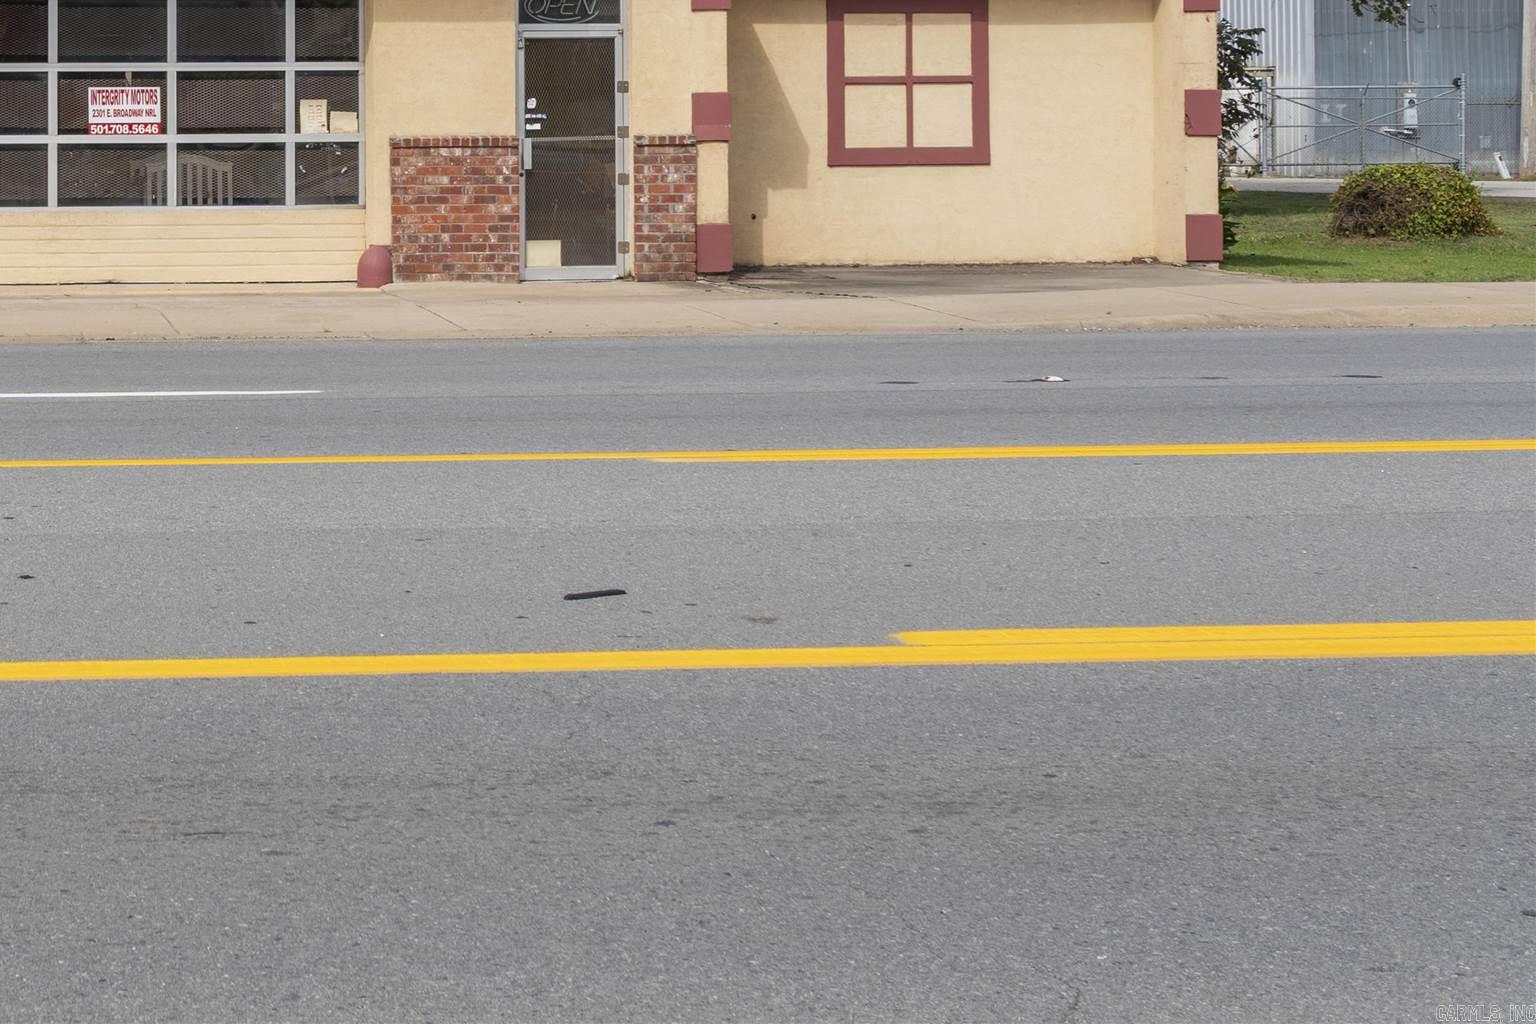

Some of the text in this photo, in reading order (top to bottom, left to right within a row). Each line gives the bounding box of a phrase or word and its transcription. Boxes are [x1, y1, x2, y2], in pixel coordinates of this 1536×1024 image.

[91, 89, 157, 105] INTERGRITY MOTORS
[92, 108, 105, 118] 2301
[113, 108, 144, 118] BROADWAY
[90, 124, 159, 135] 501.708.5646
